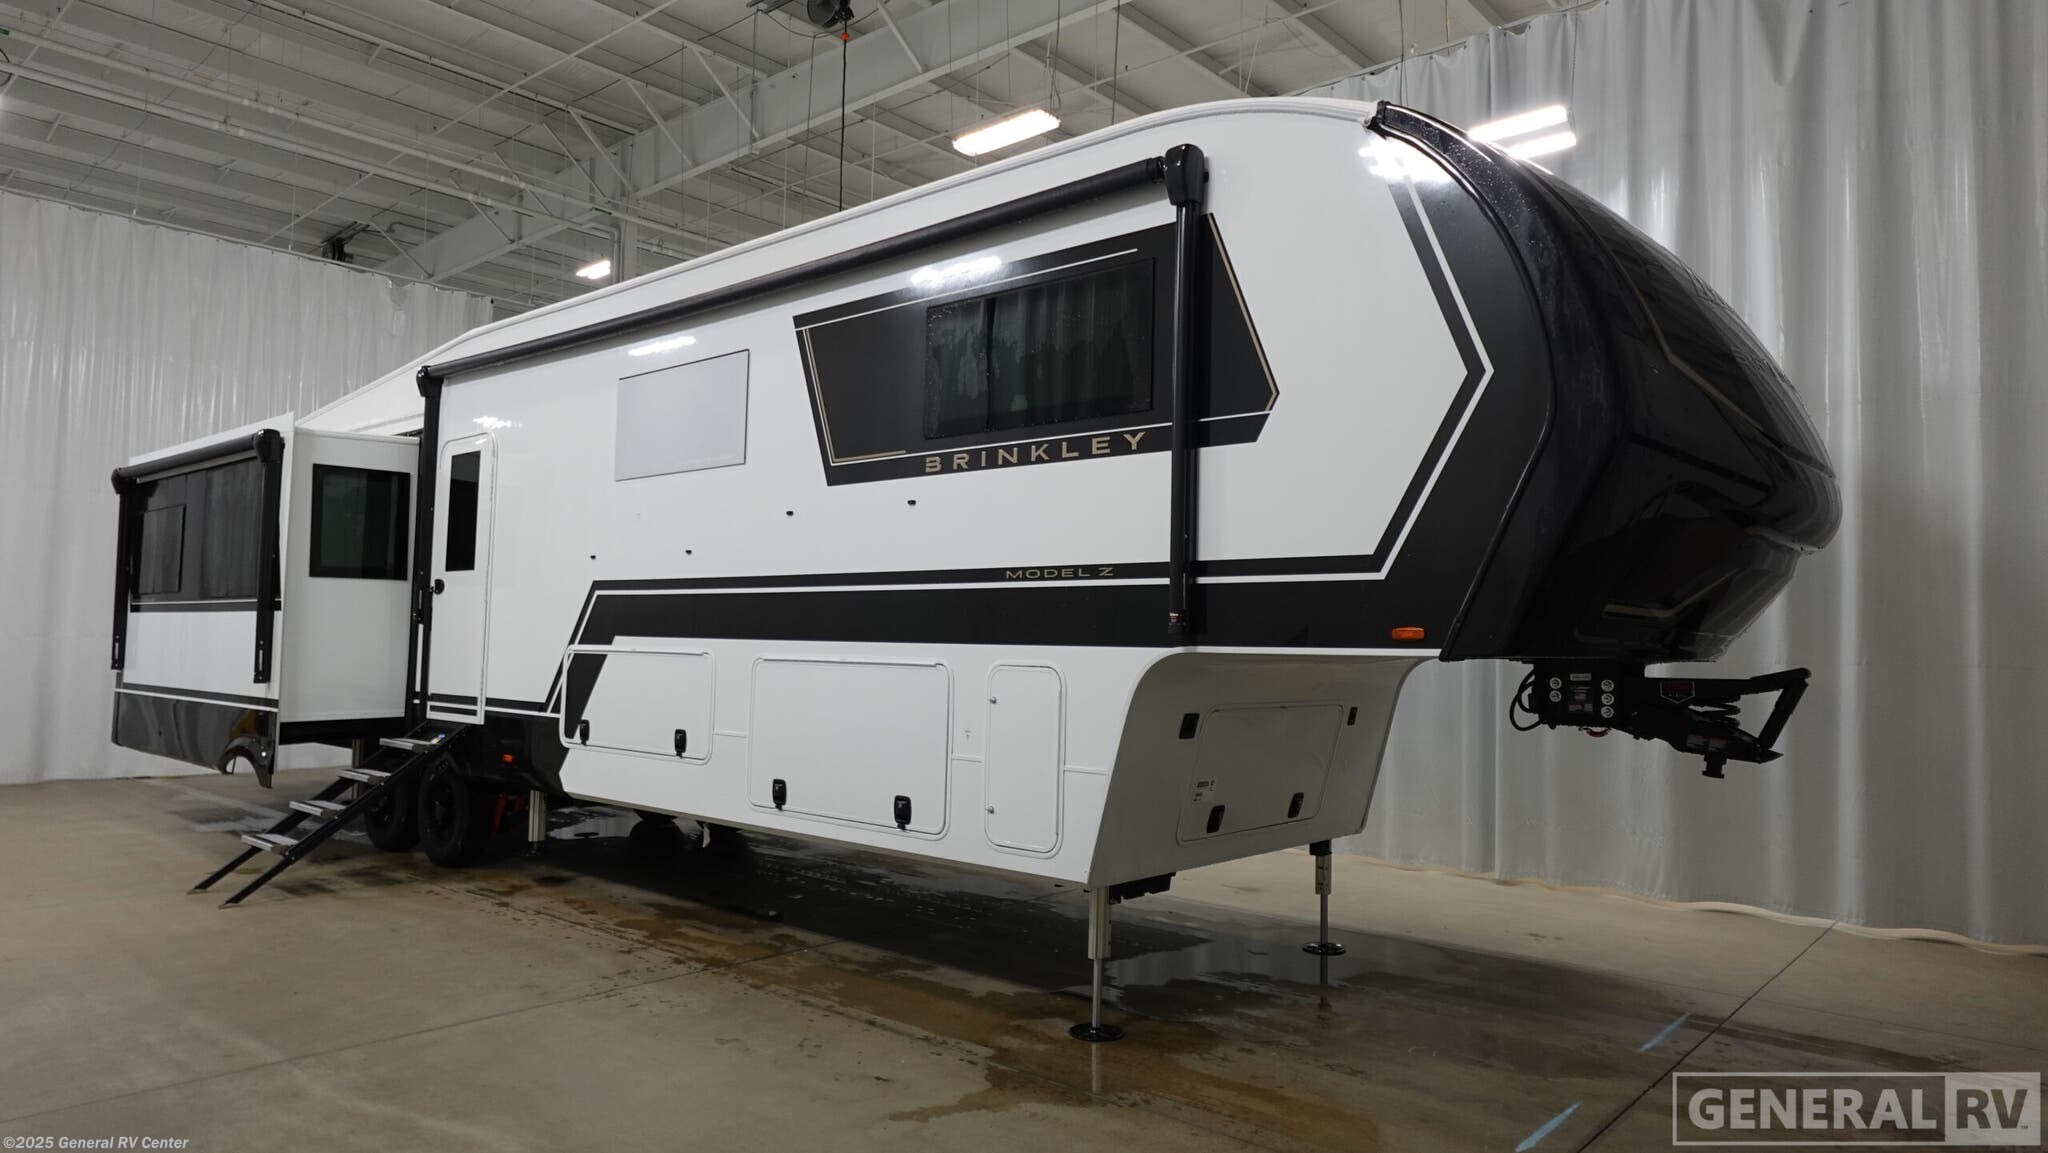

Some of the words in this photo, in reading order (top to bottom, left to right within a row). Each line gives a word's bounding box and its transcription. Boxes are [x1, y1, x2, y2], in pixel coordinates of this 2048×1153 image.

[924, 431, 1146, 473] BRINKLEY
[1006, 567, 1090, 579] MODEL
[1098, 567, 1114, 577] Z
